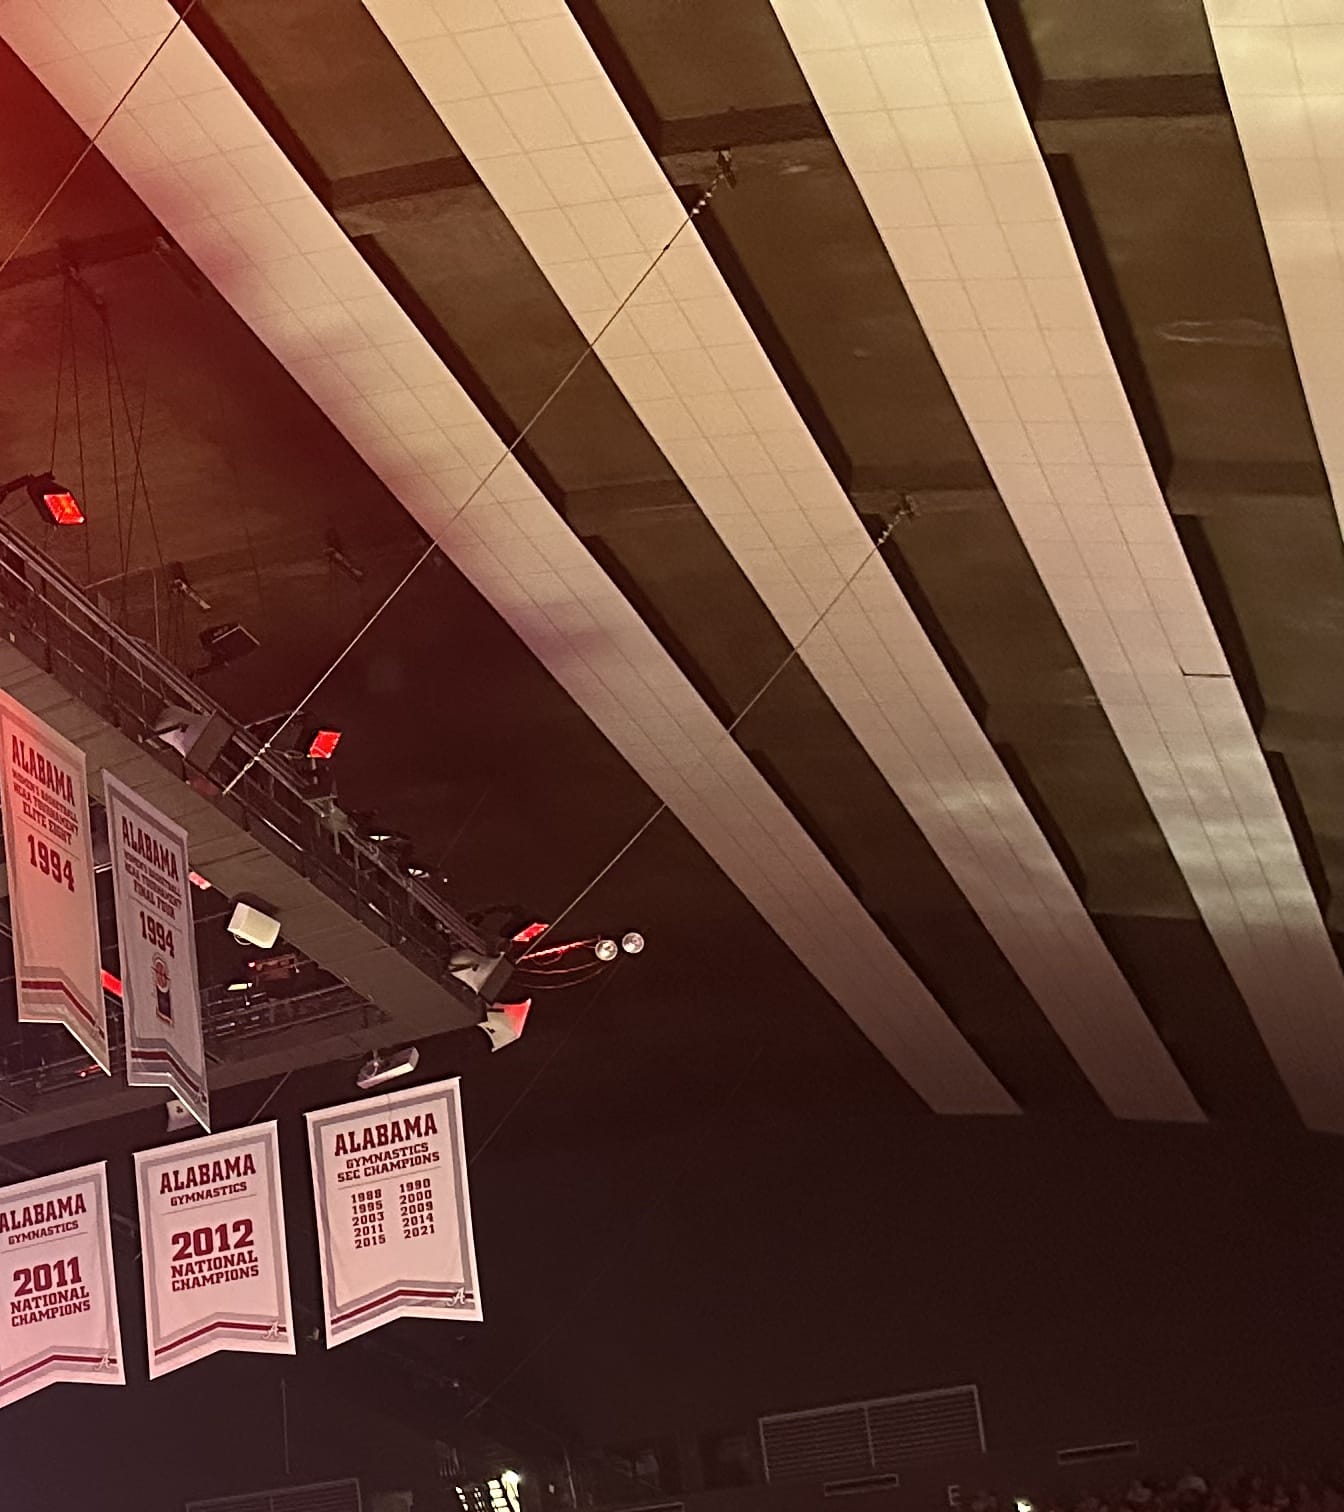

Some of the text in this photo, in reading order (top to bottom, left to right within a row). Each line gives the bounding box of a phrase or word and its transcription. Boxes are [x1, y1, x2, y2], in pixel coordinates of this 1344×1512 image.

[11, 734, 75, 807] ALABAMA
[27, 834, 75, 893] 1994
[121, 815, 179, 882] ALABAMA
[139, 910, 175, 959] 1994
[334, 1112, 438, 1157] ALABAMA
[337, 1151, 440, 1183] SEC CHAMPIONS
[345, 1142, 429, 1169] GYMNASTICS
[160, 1153, 256, 1195] ALABAMA
[170, 1181, 247, 1207] GYMNASTICS
[351, 1178, 431, 1204] 1988 1990
[352, 1189, 432, 1215] 1995 2000
[351, 1200, 433, 1227] 2003 2009
[353, 1212, 434, 1238] 2011 2014
[8, 1219, 79, 1245] GYMNASTICS
[171, 1218, 254, 1262] 2012
[354, 1223, 435, 1249] 2015 2021
[13, 1256, 82, 1298] 2011
[170, 1249, 258, 1279] NATIONAL
[171, 1264, 259, 1292] CHAMPIONS
[10, 1285, 90, 1315] NATIONAL
[11, 1299, 91, 1327] CHAMPIONS
